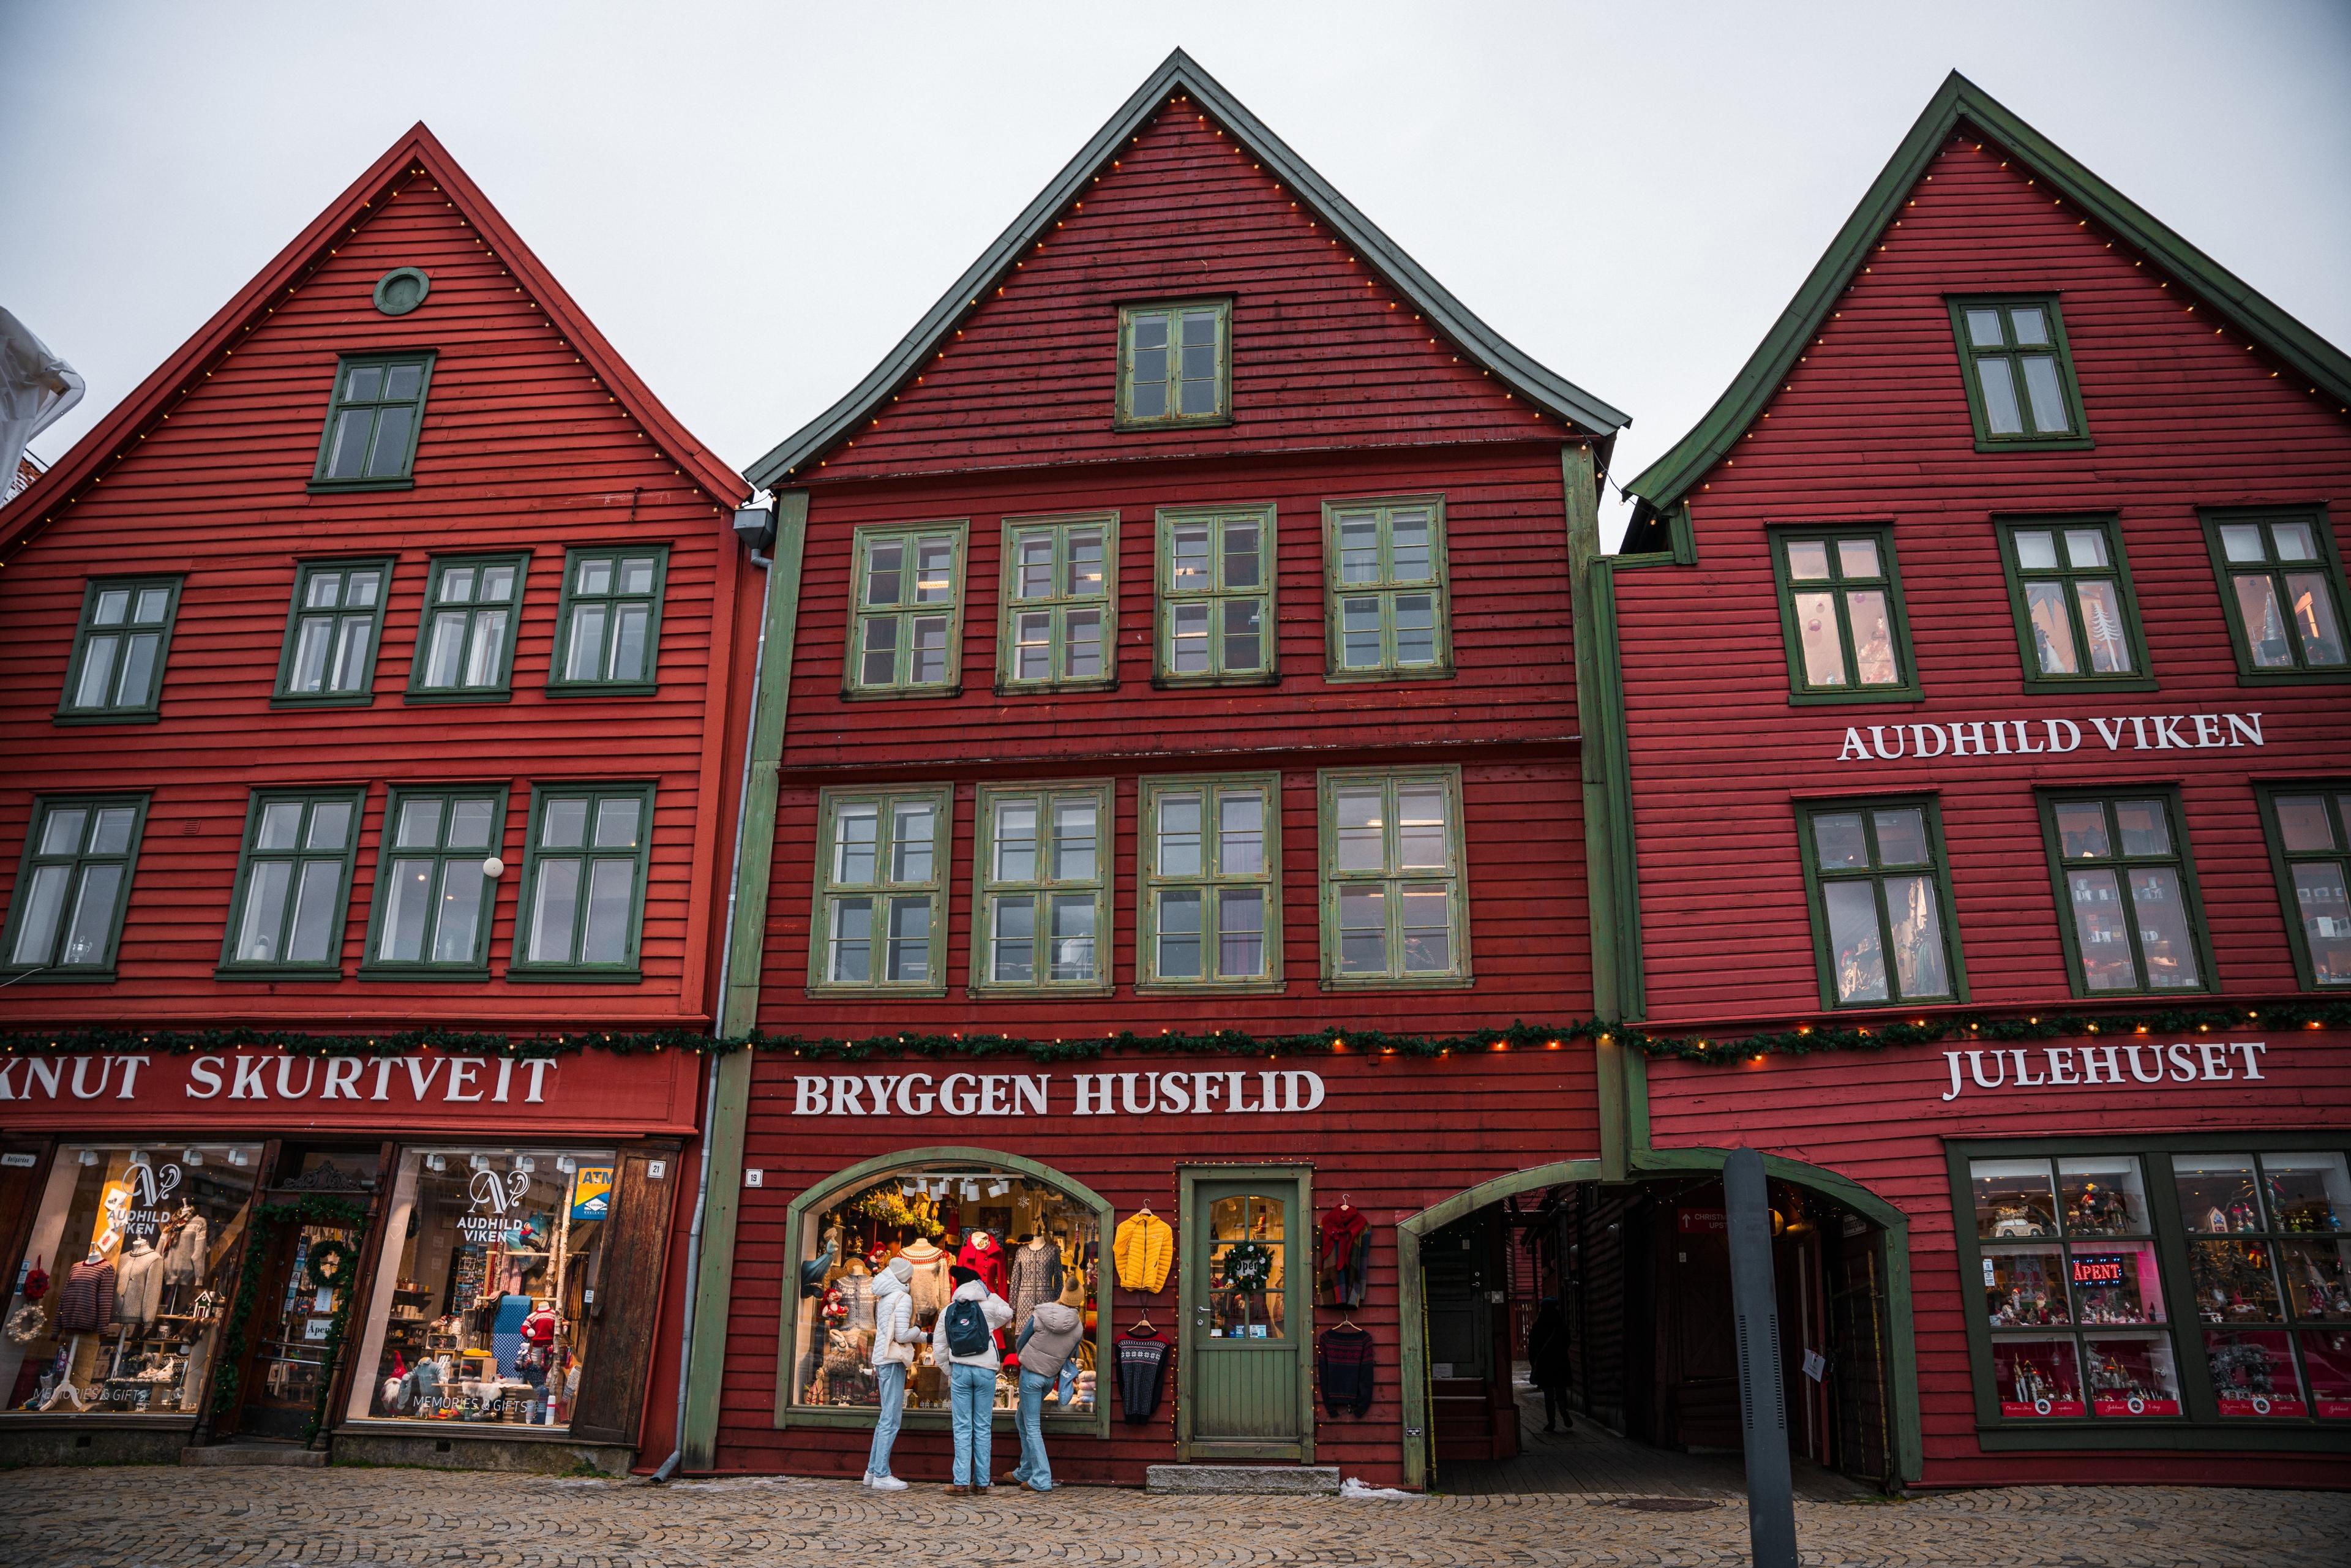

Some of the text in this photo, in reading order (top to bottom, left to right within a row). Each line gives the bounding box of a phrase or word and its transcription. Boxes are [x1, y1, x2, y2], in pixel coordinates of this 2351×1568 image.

[1836, 712, 2265, 761] AUDHILD VIKEN
[186, 1056, 557, 1103] SKURTVEIT
[1942, 1042, 2267, 1101] JULEHUSET
[791, 1070, 1325, 1116] BRYGGEN HUSFLID
[582, 1171, 613, 1184] ATM
[653, 1165, 660, 1174] 21
[107, 1209, 170, 1223] AUDHILD
[456, 1217, 523, 1230] AUDHILD
[113, 1222, 154, 1235] VIKEN
[464, 1229, 507, 1243] VIKEN
[2074, 1262, 2120, 1281] ÅPENT
[413, 1395, 528, 1413] MEMORIES & GIFTS
